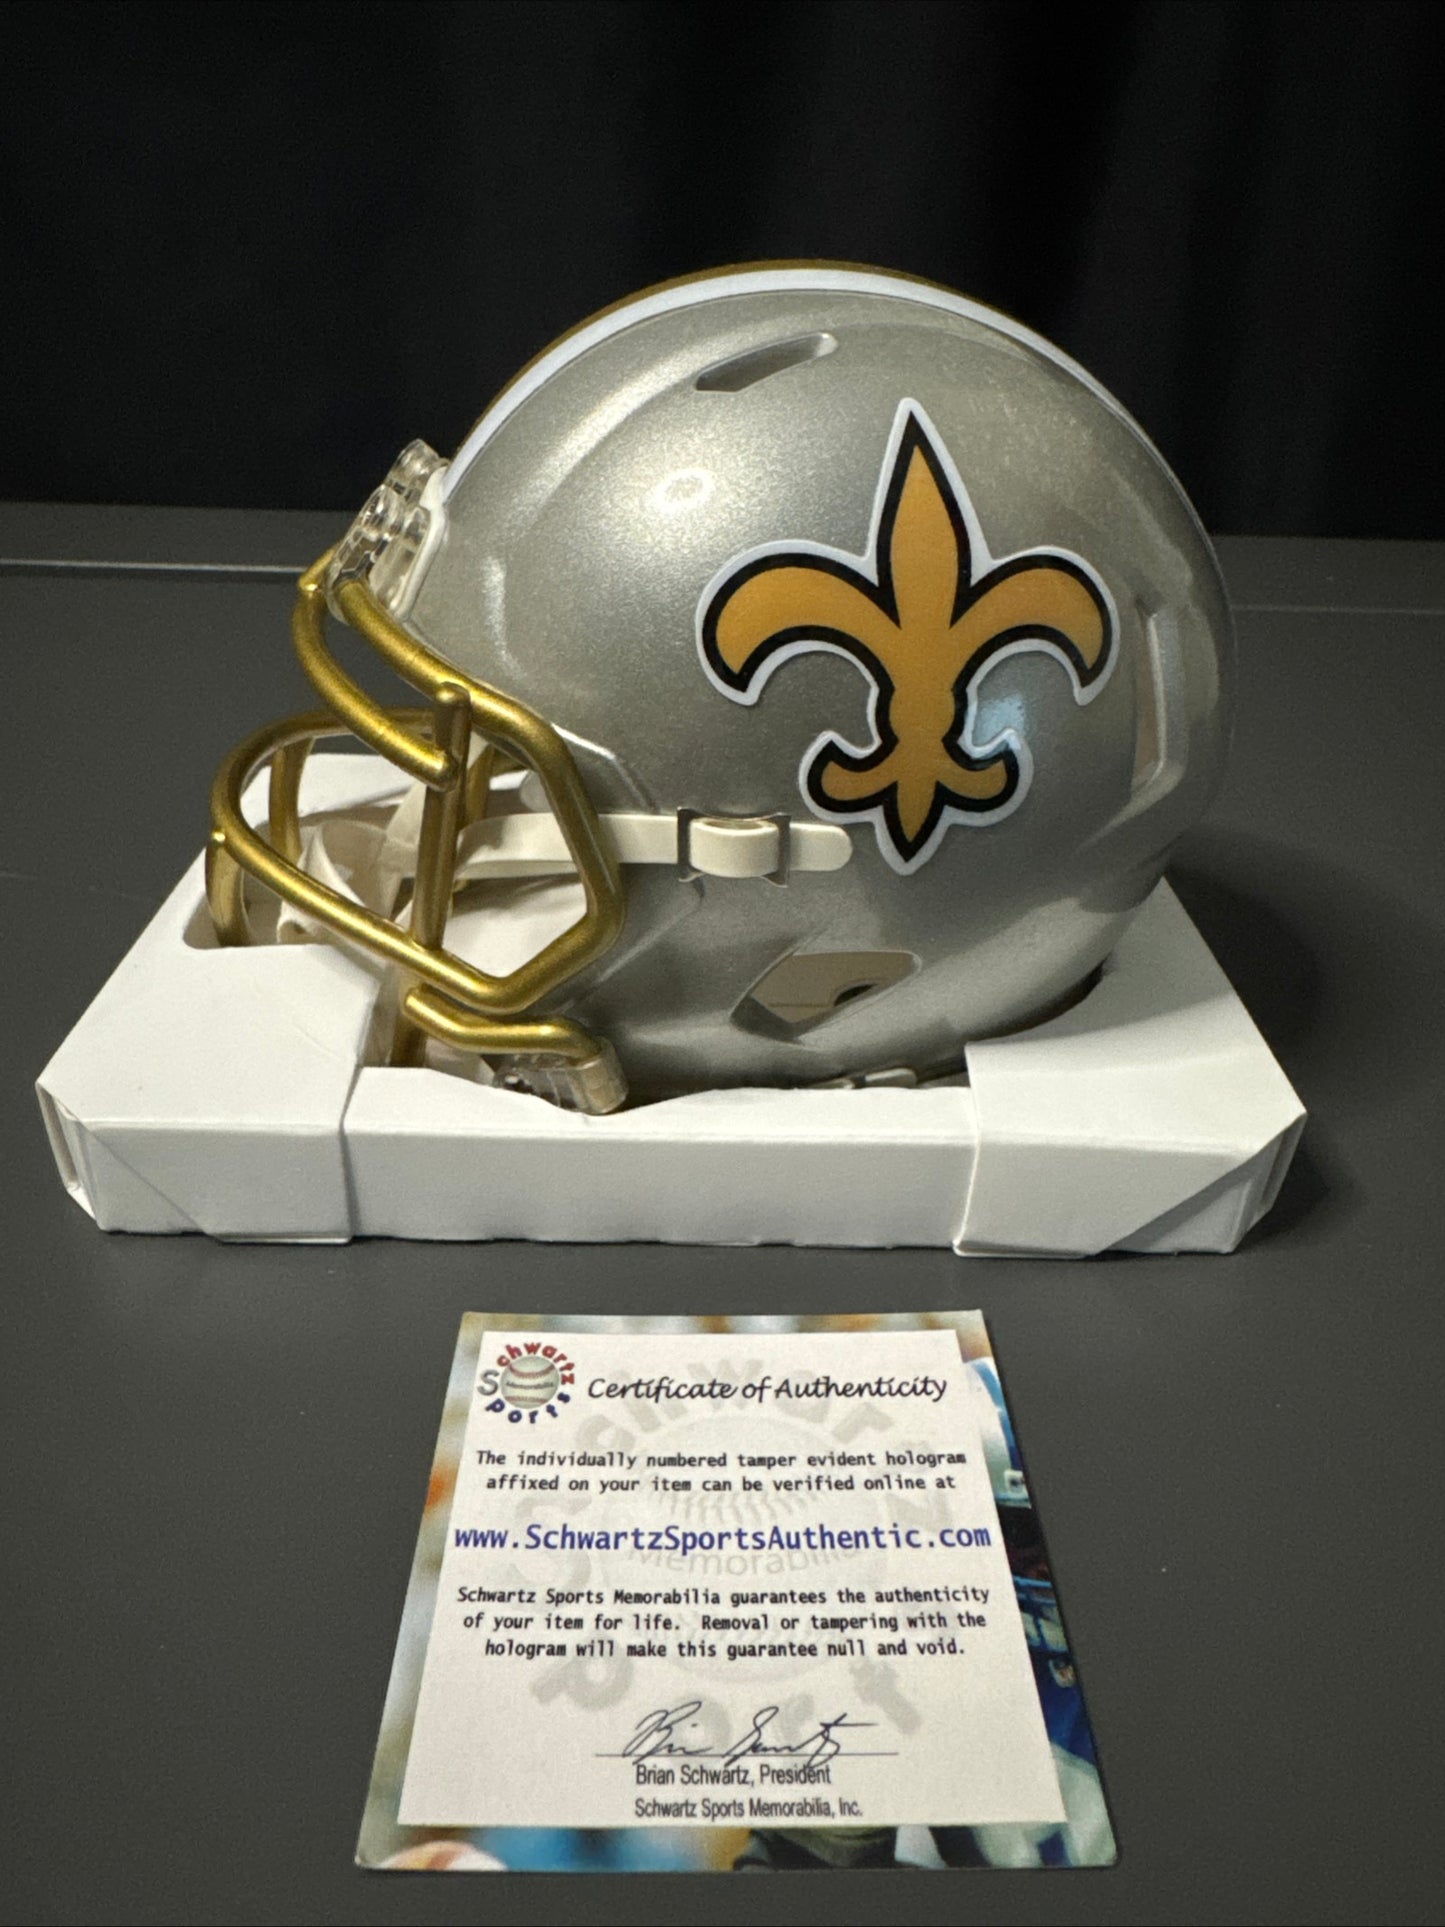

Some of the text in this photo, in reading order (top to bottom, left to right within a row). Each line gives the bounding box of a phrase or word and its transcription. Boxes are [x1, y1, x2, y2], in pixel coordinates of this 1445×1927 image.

[588, 1375, 947, 1403] Certificate of Authenticity
[477, 1450, 967, 1470] The individually numbered tamper evident hologram
[486, 1474, 956, 1494] affixed on your item can be verified online at
[455, 1523, 991, 1555] www.SchwartzSportsAuthentic.com
[457, 1585, 989, 1608] Schwartz Sports Memorabilia guarantees the authenticity
[463, 1610, 986, 1633] of your item for life. Removal or tampering with the
[485, 1637, 965, 1661] hologram will make this guarantee null and void.
[636, 1764, 831, 1787] Brian Schwartz, President
[635, 1797, 863, 1820] Schwartz Sports Memorabilia, Inc.
